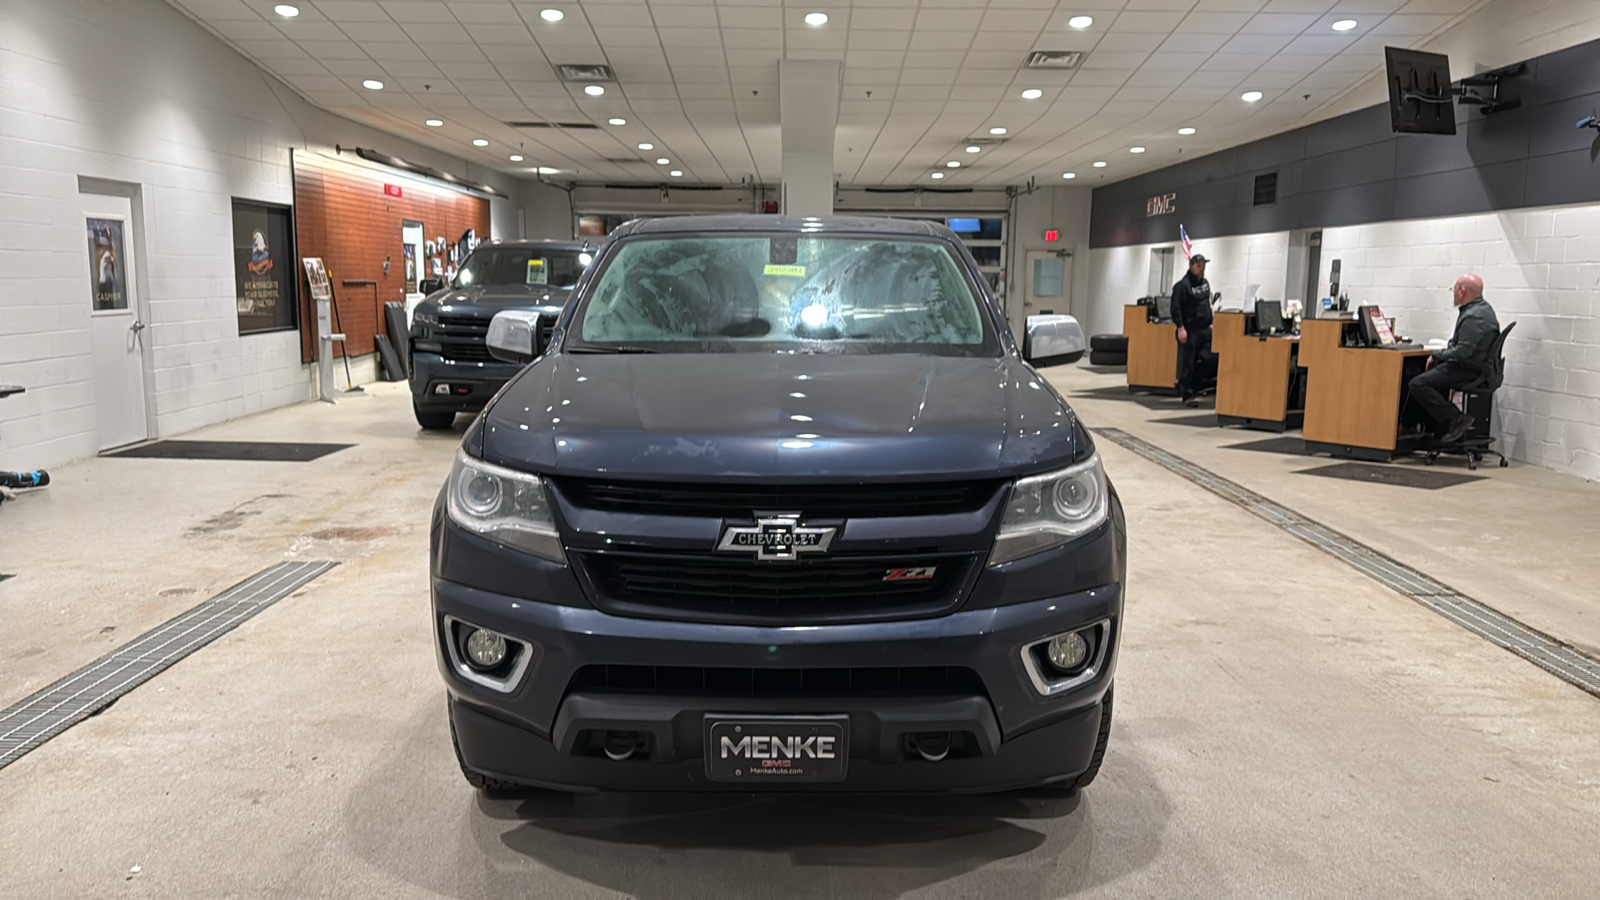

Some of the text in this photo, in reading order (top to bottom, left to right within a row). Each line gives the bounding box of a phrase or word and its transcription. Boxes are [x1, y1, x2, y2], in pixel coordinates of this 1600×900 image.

[1147, 192, 1176, 217] GMC
[738, 533, 817, 546] CHEVROLET
[882, 566, 937, 581] Z71
[721, 736, 836, 759] MENKE
[750, 767, 803, 775] MenkeAuto.com
